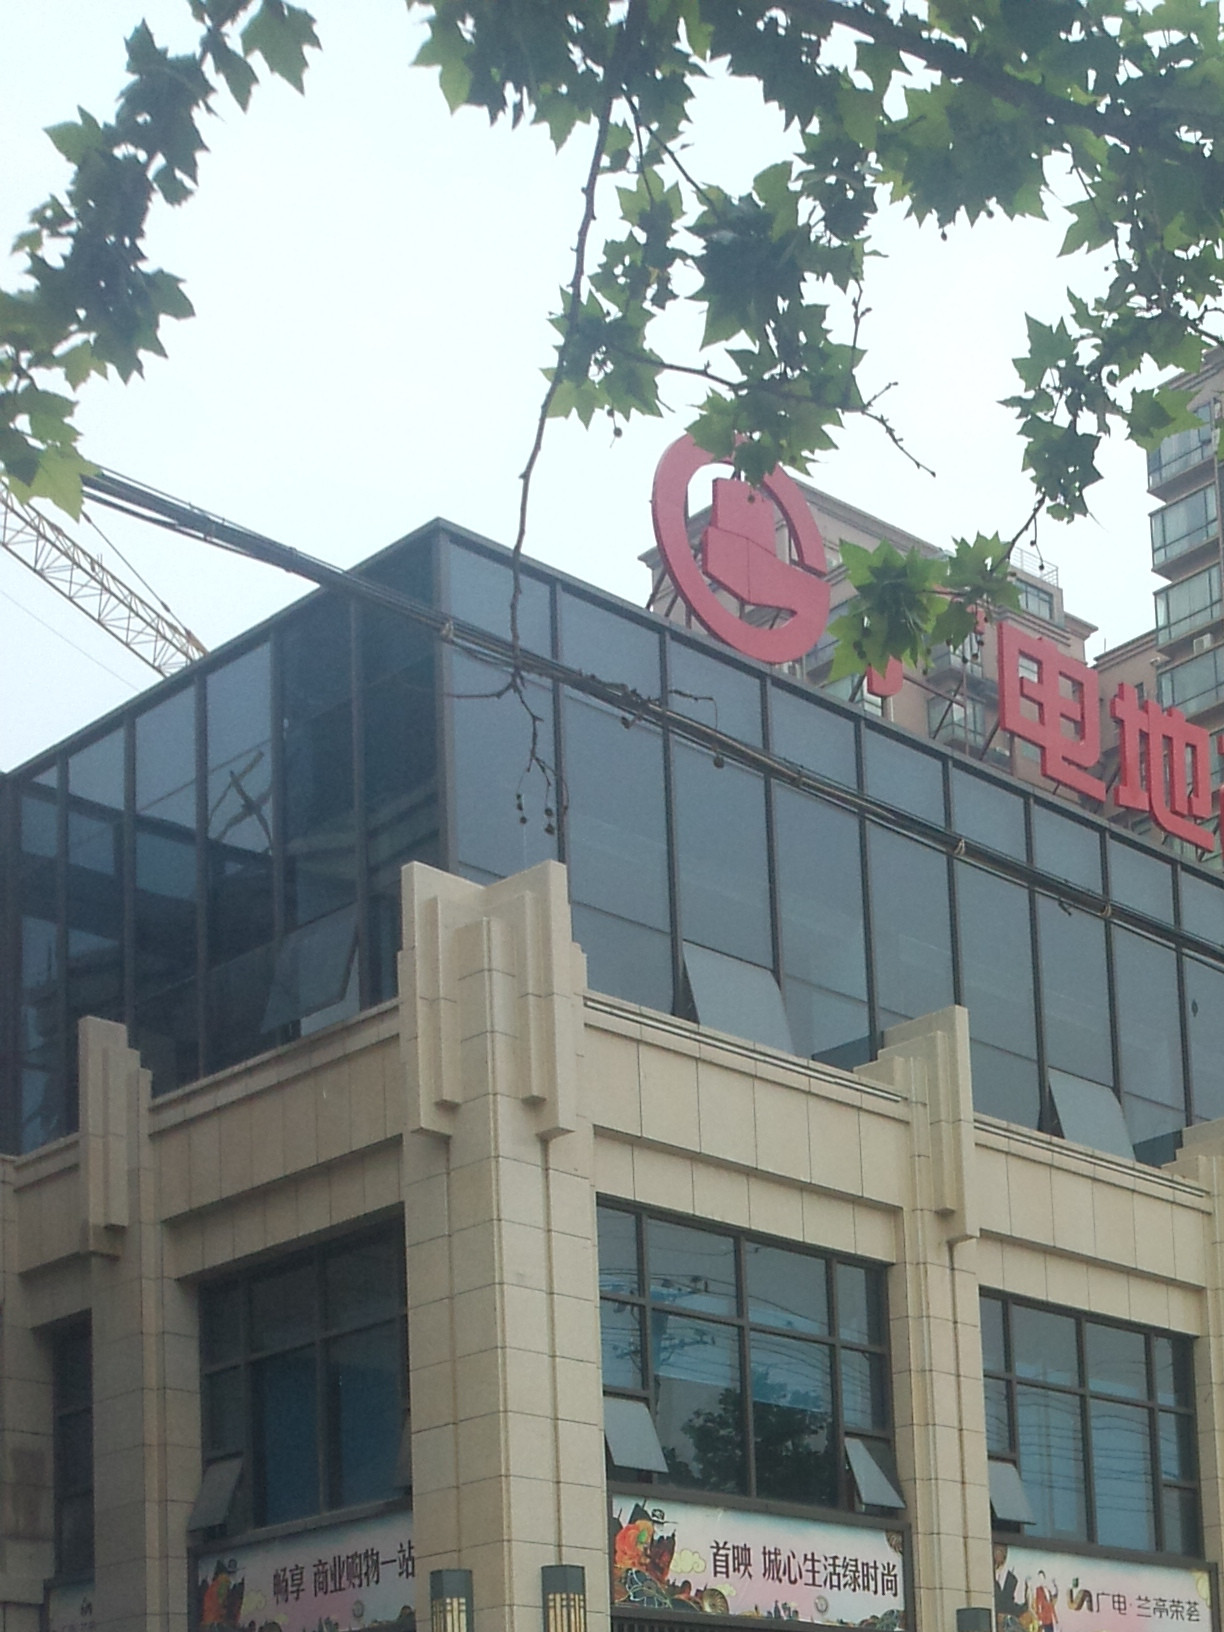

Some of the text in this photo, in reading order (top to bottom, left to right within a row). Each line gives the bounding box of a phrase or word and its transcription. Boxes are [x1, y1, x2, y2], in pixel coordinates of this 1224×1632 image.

[709, 1539, 899, 1598] 首映 城心生活绿时尚
